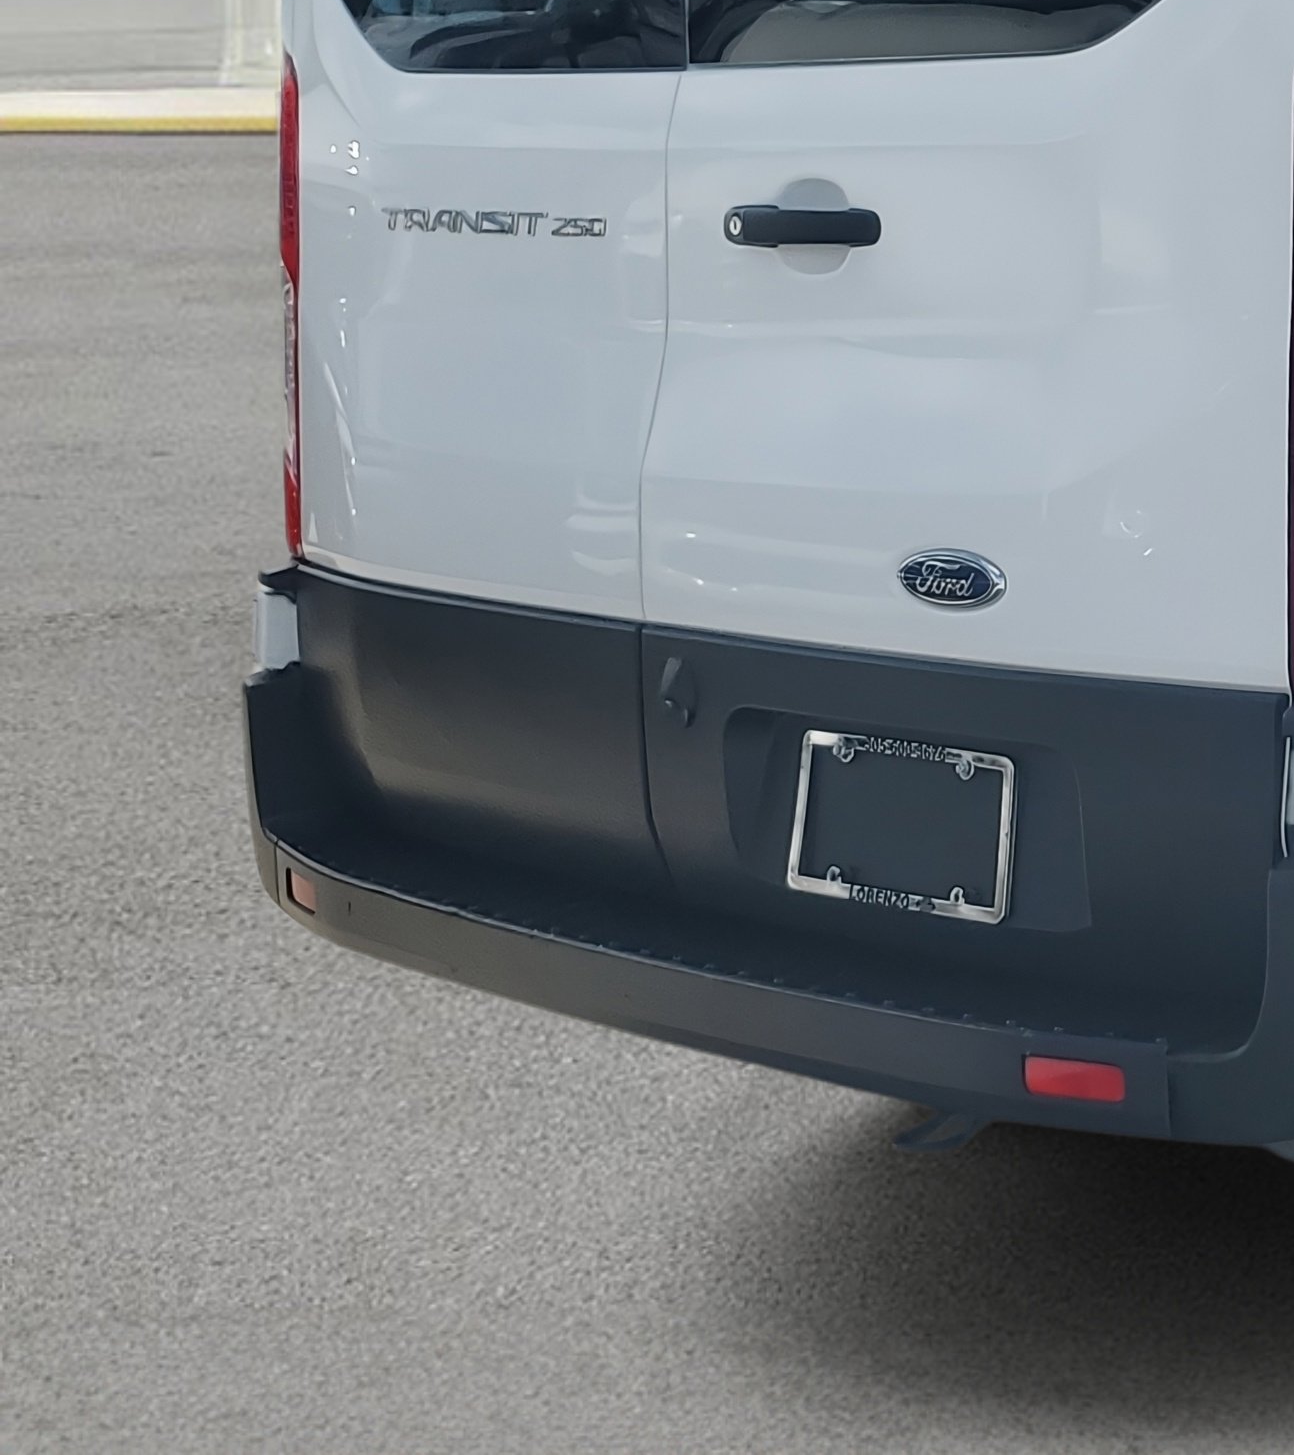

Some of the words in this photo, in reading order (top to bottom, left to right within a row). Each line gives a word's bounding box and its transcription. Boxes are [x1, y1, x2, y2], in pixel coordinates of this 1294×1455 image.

[381, 207, 548, 237] TRANSIT
[551, 217, 608, 237] 250
[916, 560, 975, 596] Ford
[849, 884, 911, 909] LORENZO
